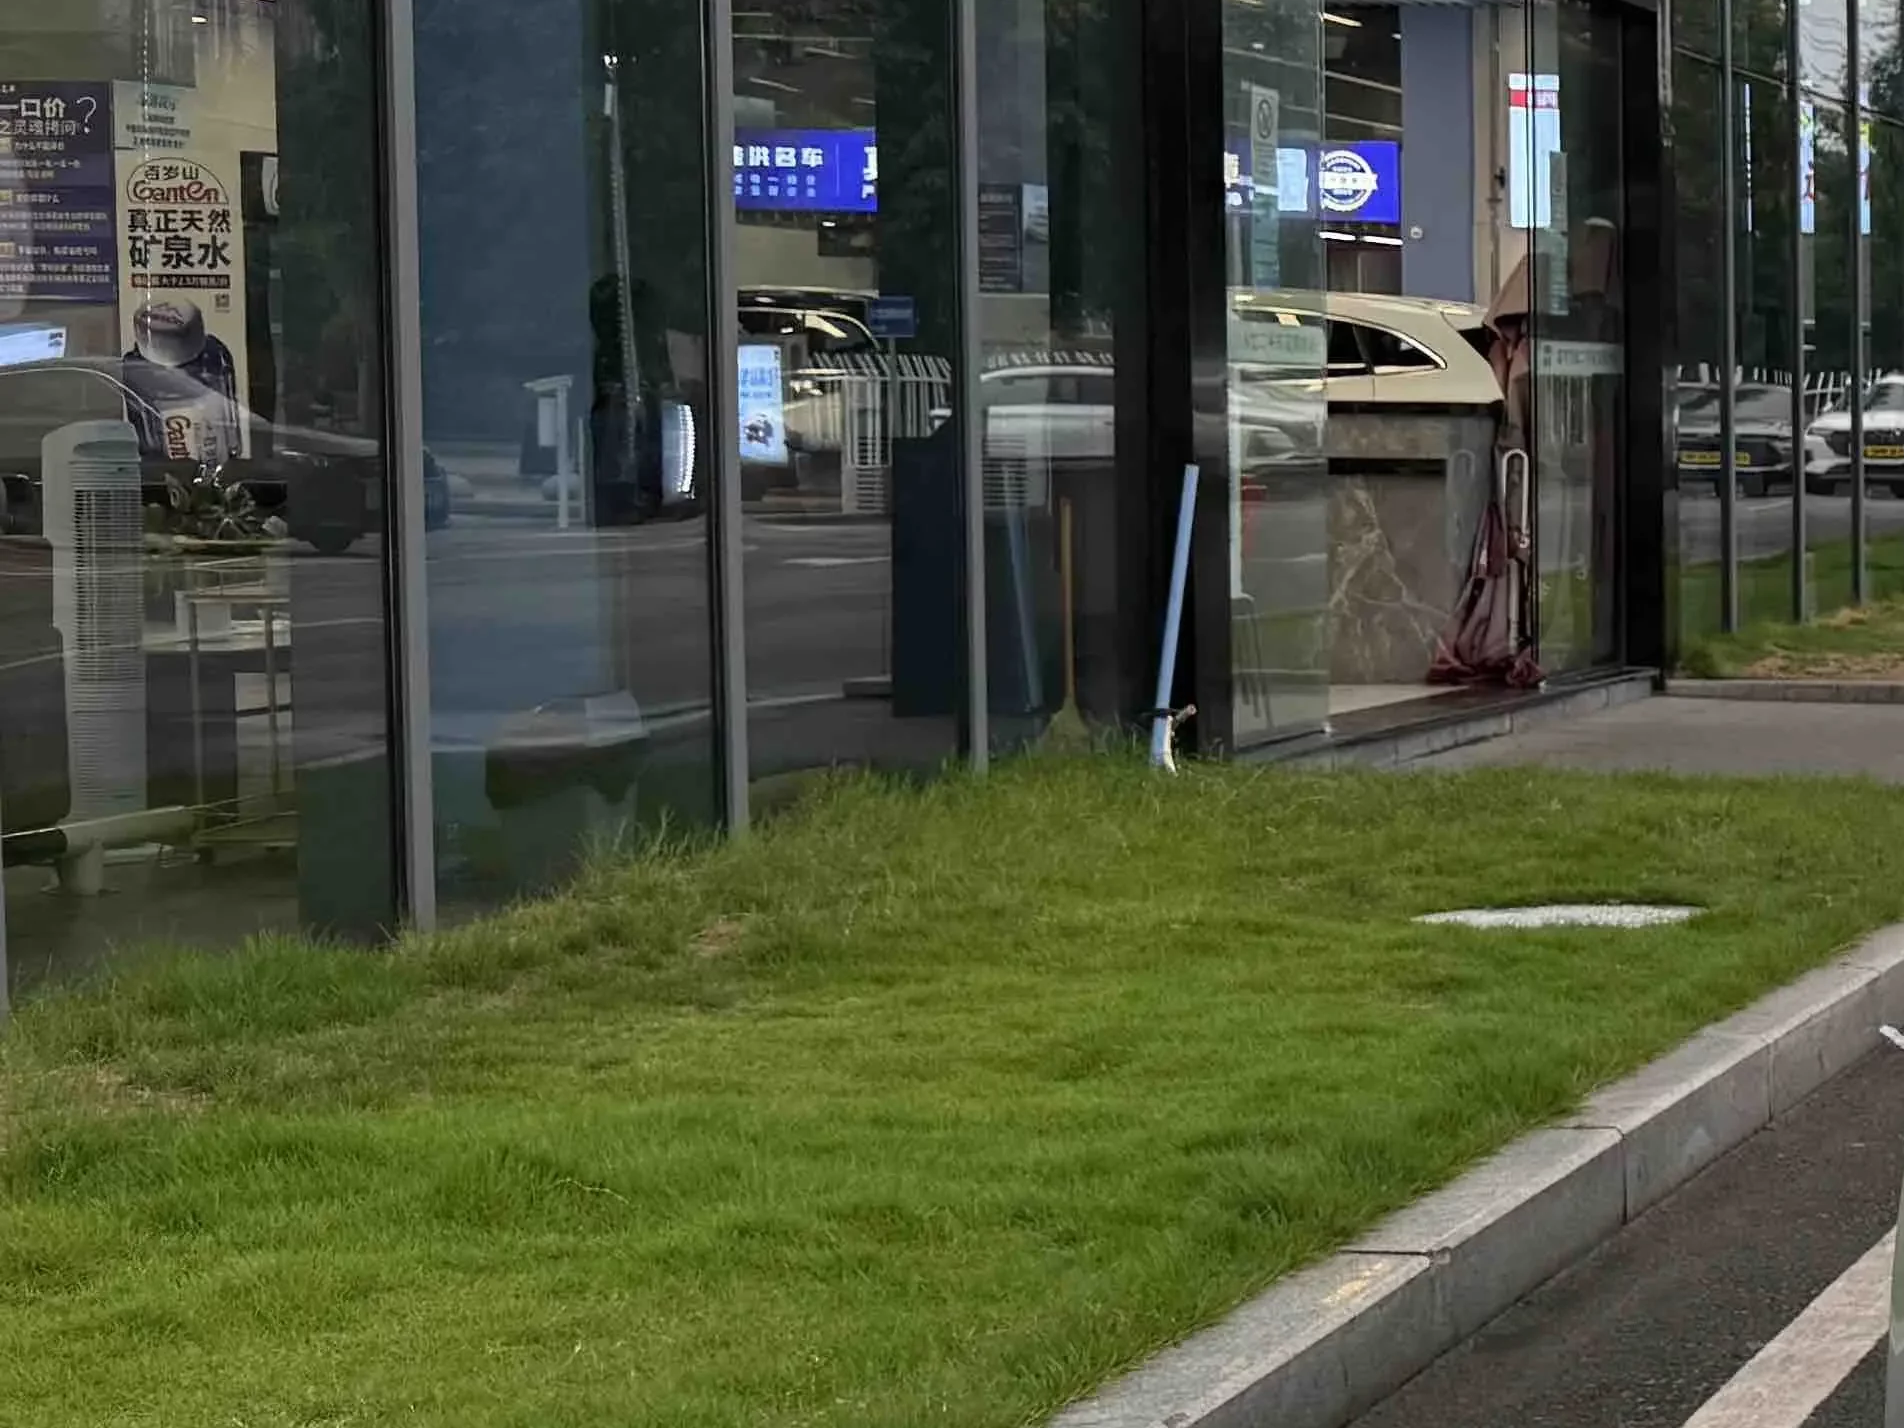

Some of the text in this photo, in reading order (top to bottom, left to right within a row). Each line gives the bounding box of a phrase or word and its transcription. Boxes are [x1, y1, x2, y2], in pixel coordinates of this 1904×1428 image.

[144, 165, 199, 181] 百岁山
[132, 179, 220, 203] Ganten
[127, 209, 231, 234] 真正天然
[128, 235, 231, 270] 矿泉水
